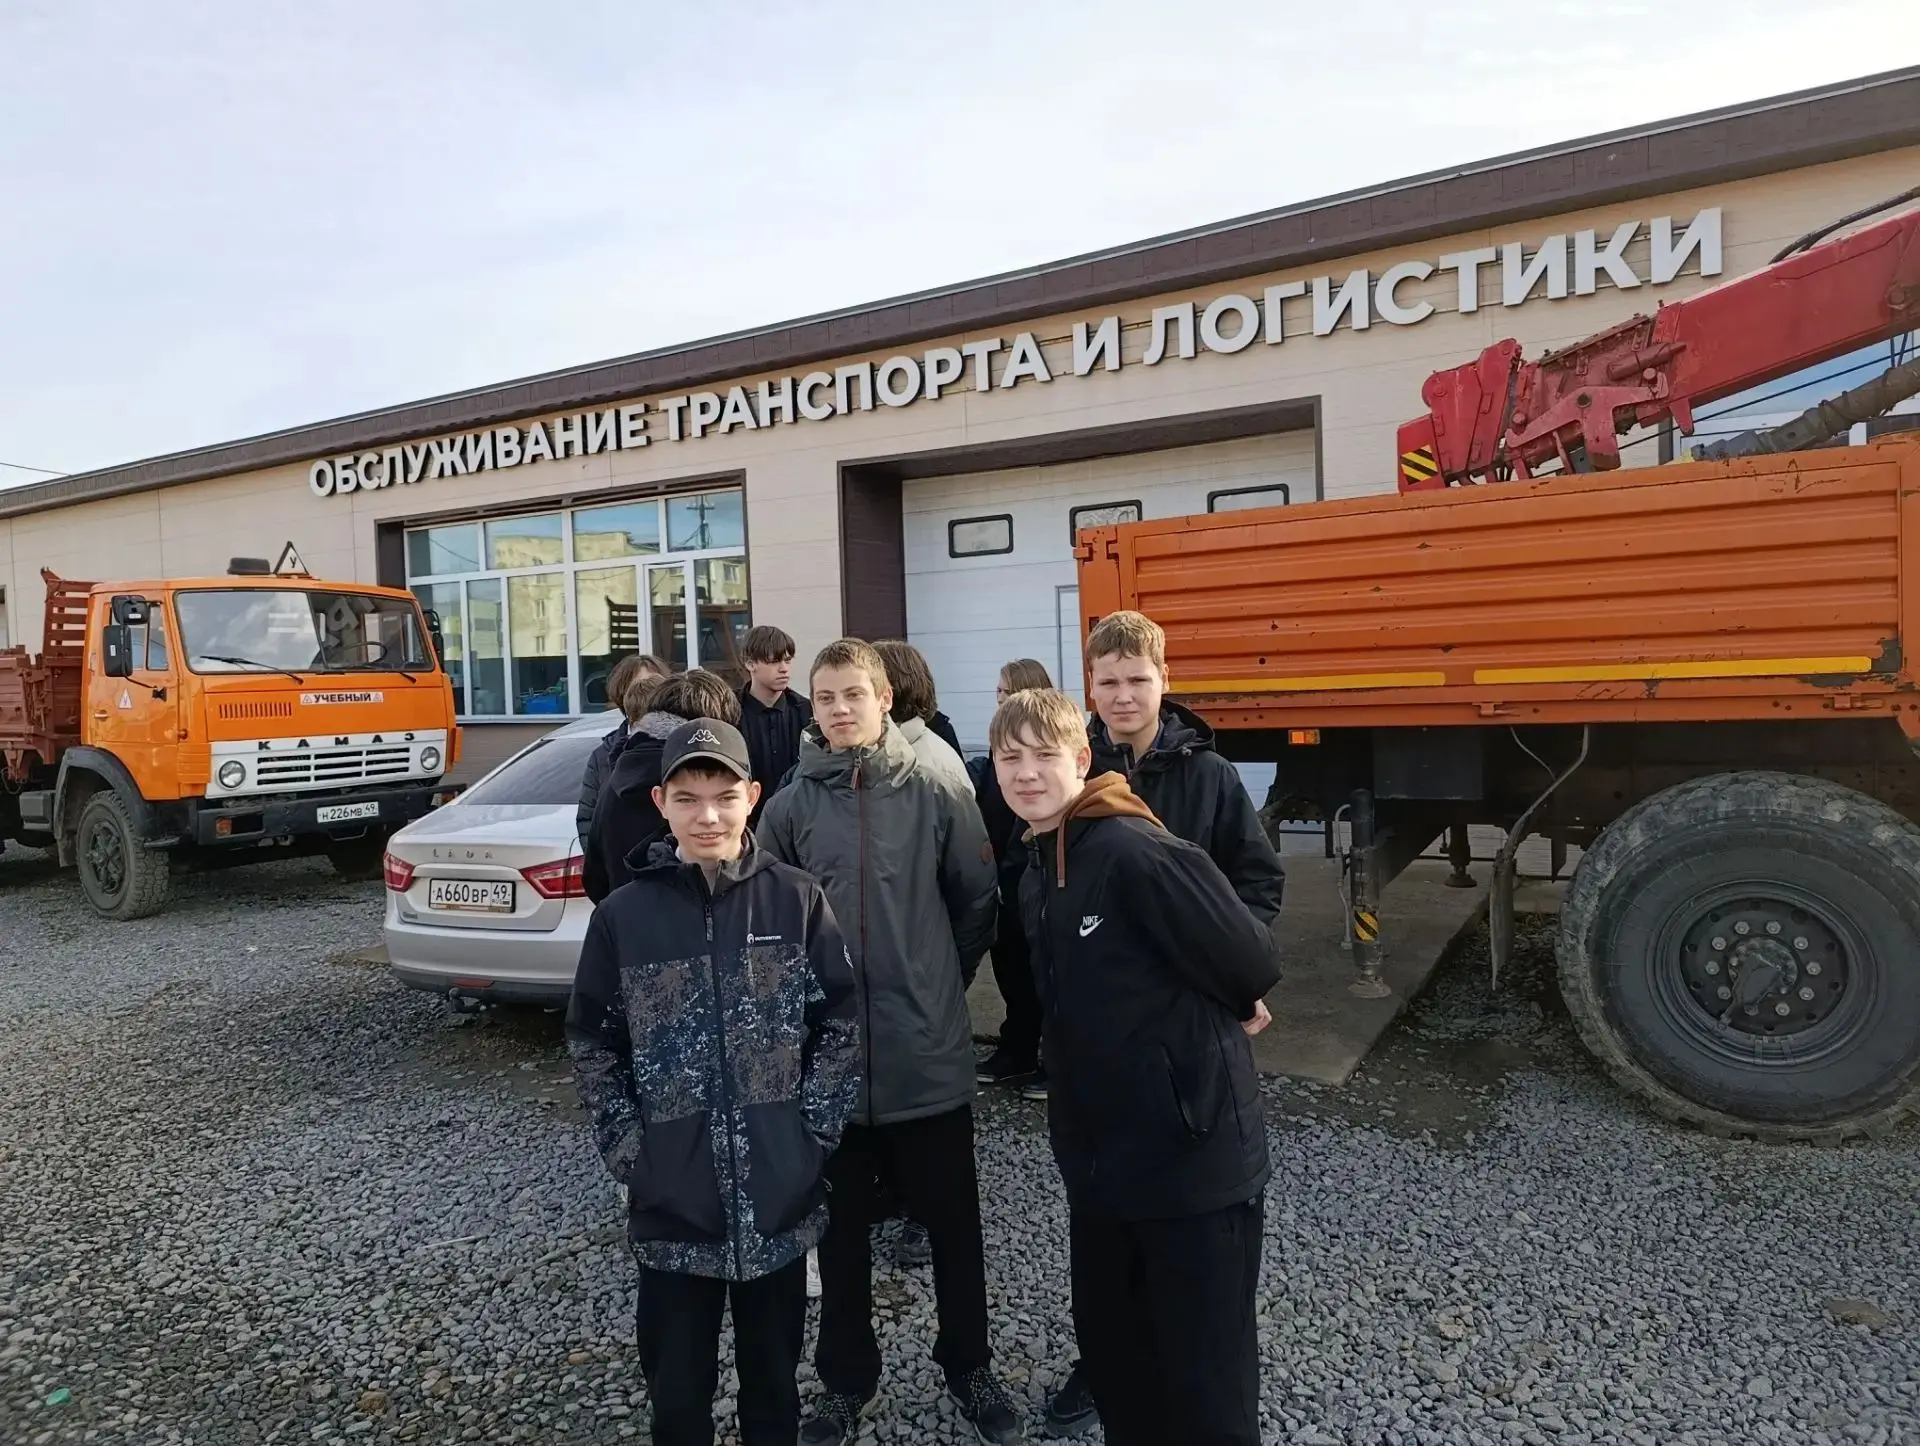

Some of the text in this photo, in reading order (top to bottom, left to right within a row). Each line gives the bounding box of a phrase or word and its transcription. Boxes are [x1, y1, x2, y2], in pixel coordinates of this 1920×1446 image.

[309, 207, 1723, 497] ОБСЛУЖИВАНИЕ ТРАНСПОРТА И ЛОГИСТИКИ
[289, 556, 297, 568] У
[314, 692, 372, 703] УЧЕБНЫЙ
[258, 732, 415, 750] КАМАЗ
[1082, 915, 1099, 926] NIKE
